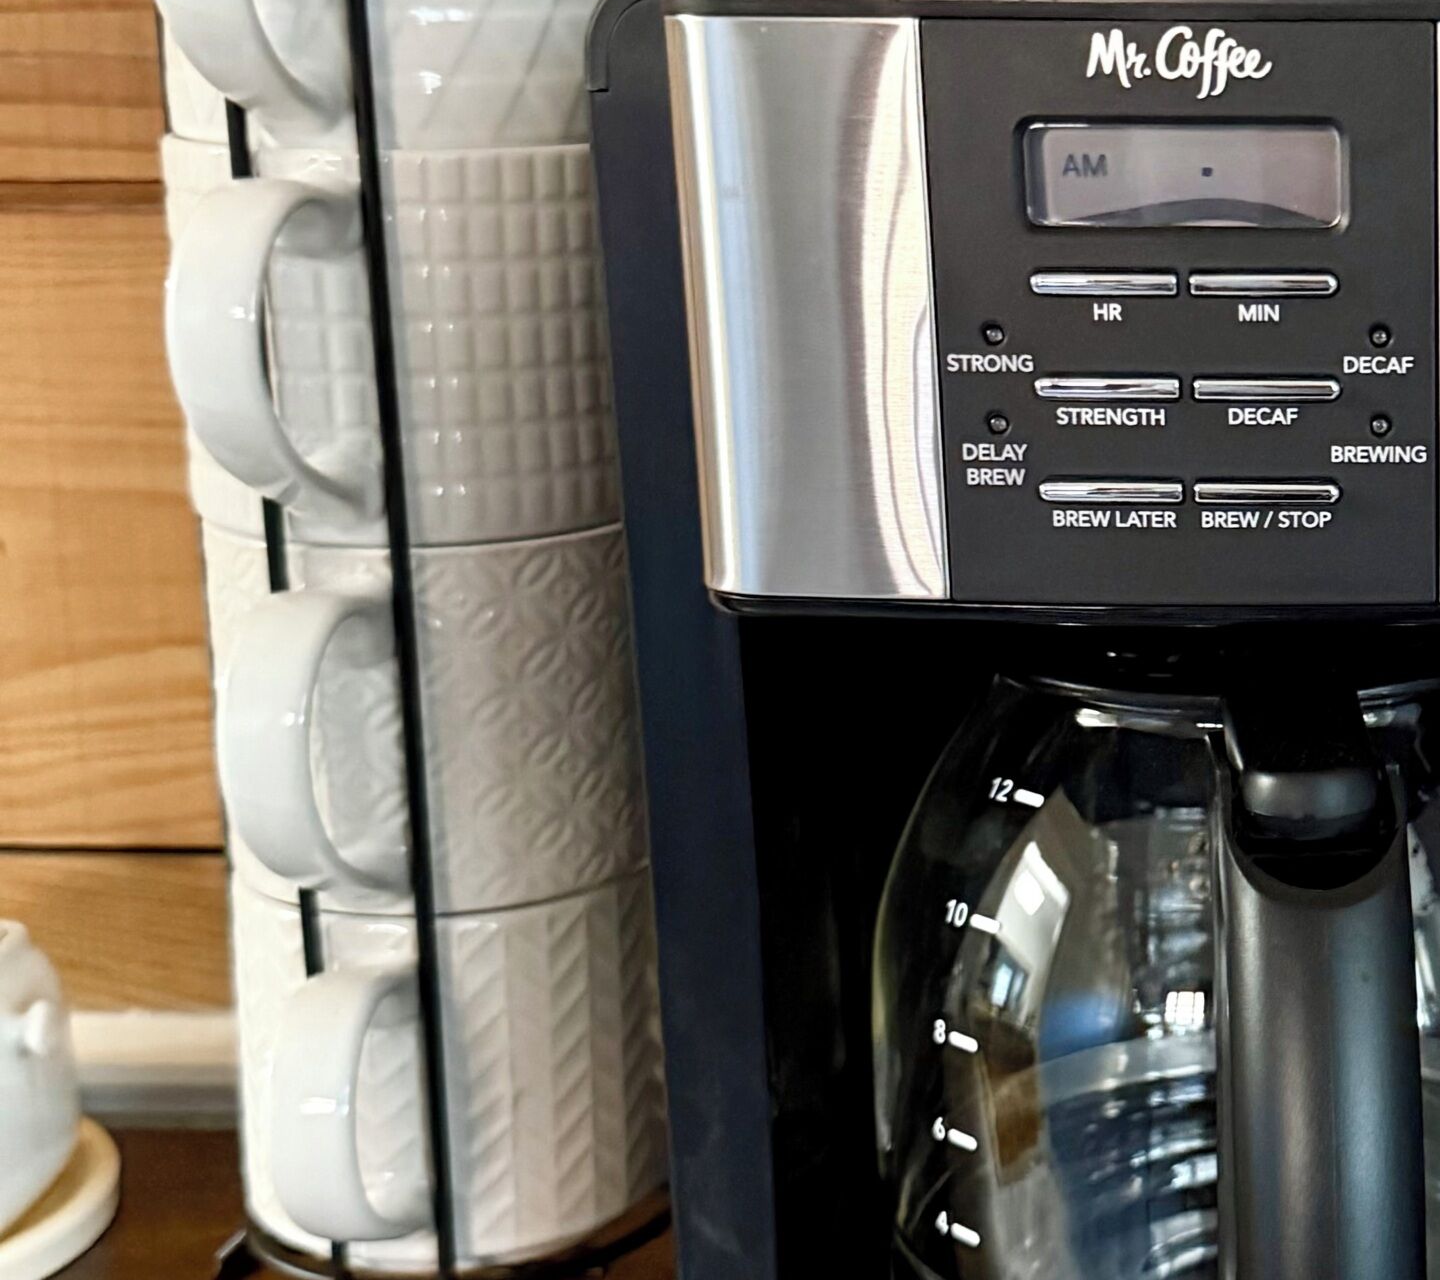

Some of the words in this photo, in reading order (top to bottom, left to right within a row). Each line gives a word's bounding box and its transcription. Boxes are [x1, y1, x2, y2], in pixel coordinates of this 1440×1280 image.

[1086, 28, 1152, 89] Mr.
[1155, 24, 1273, 99] Coffee
[1062, 153, 1108, 178] AM
[1093, 304, 1122, 322] HR
[1238, 304, 1280, 323] MIN
[946, 354, 1034, 374] STRONG
[1342, 355, 1415, 375] DECAF
[1056, 407, 1166, 426] STRENGTH
[1228, 407, 1299, 426] DECAF
[962, 443, 1028, 463] DELAY
[1330, 445, 1427, 464] BREWING
[966, 468, 1025, 486] BREW
[1052, 510, 1112, 528] BREW
[1115, 510, 1177, 528] LATER
[1201, 511, 1260, 529] BREW
[1277, 511, 1332, 529] STOP
[988, 777, 1014, 802] 12
[945, 899, 969, 928] 10
[933, 1019, 946, 1045] 8
[932, 1116, 946, 1141] 6
[935, 1210, 949, 1236] 4
